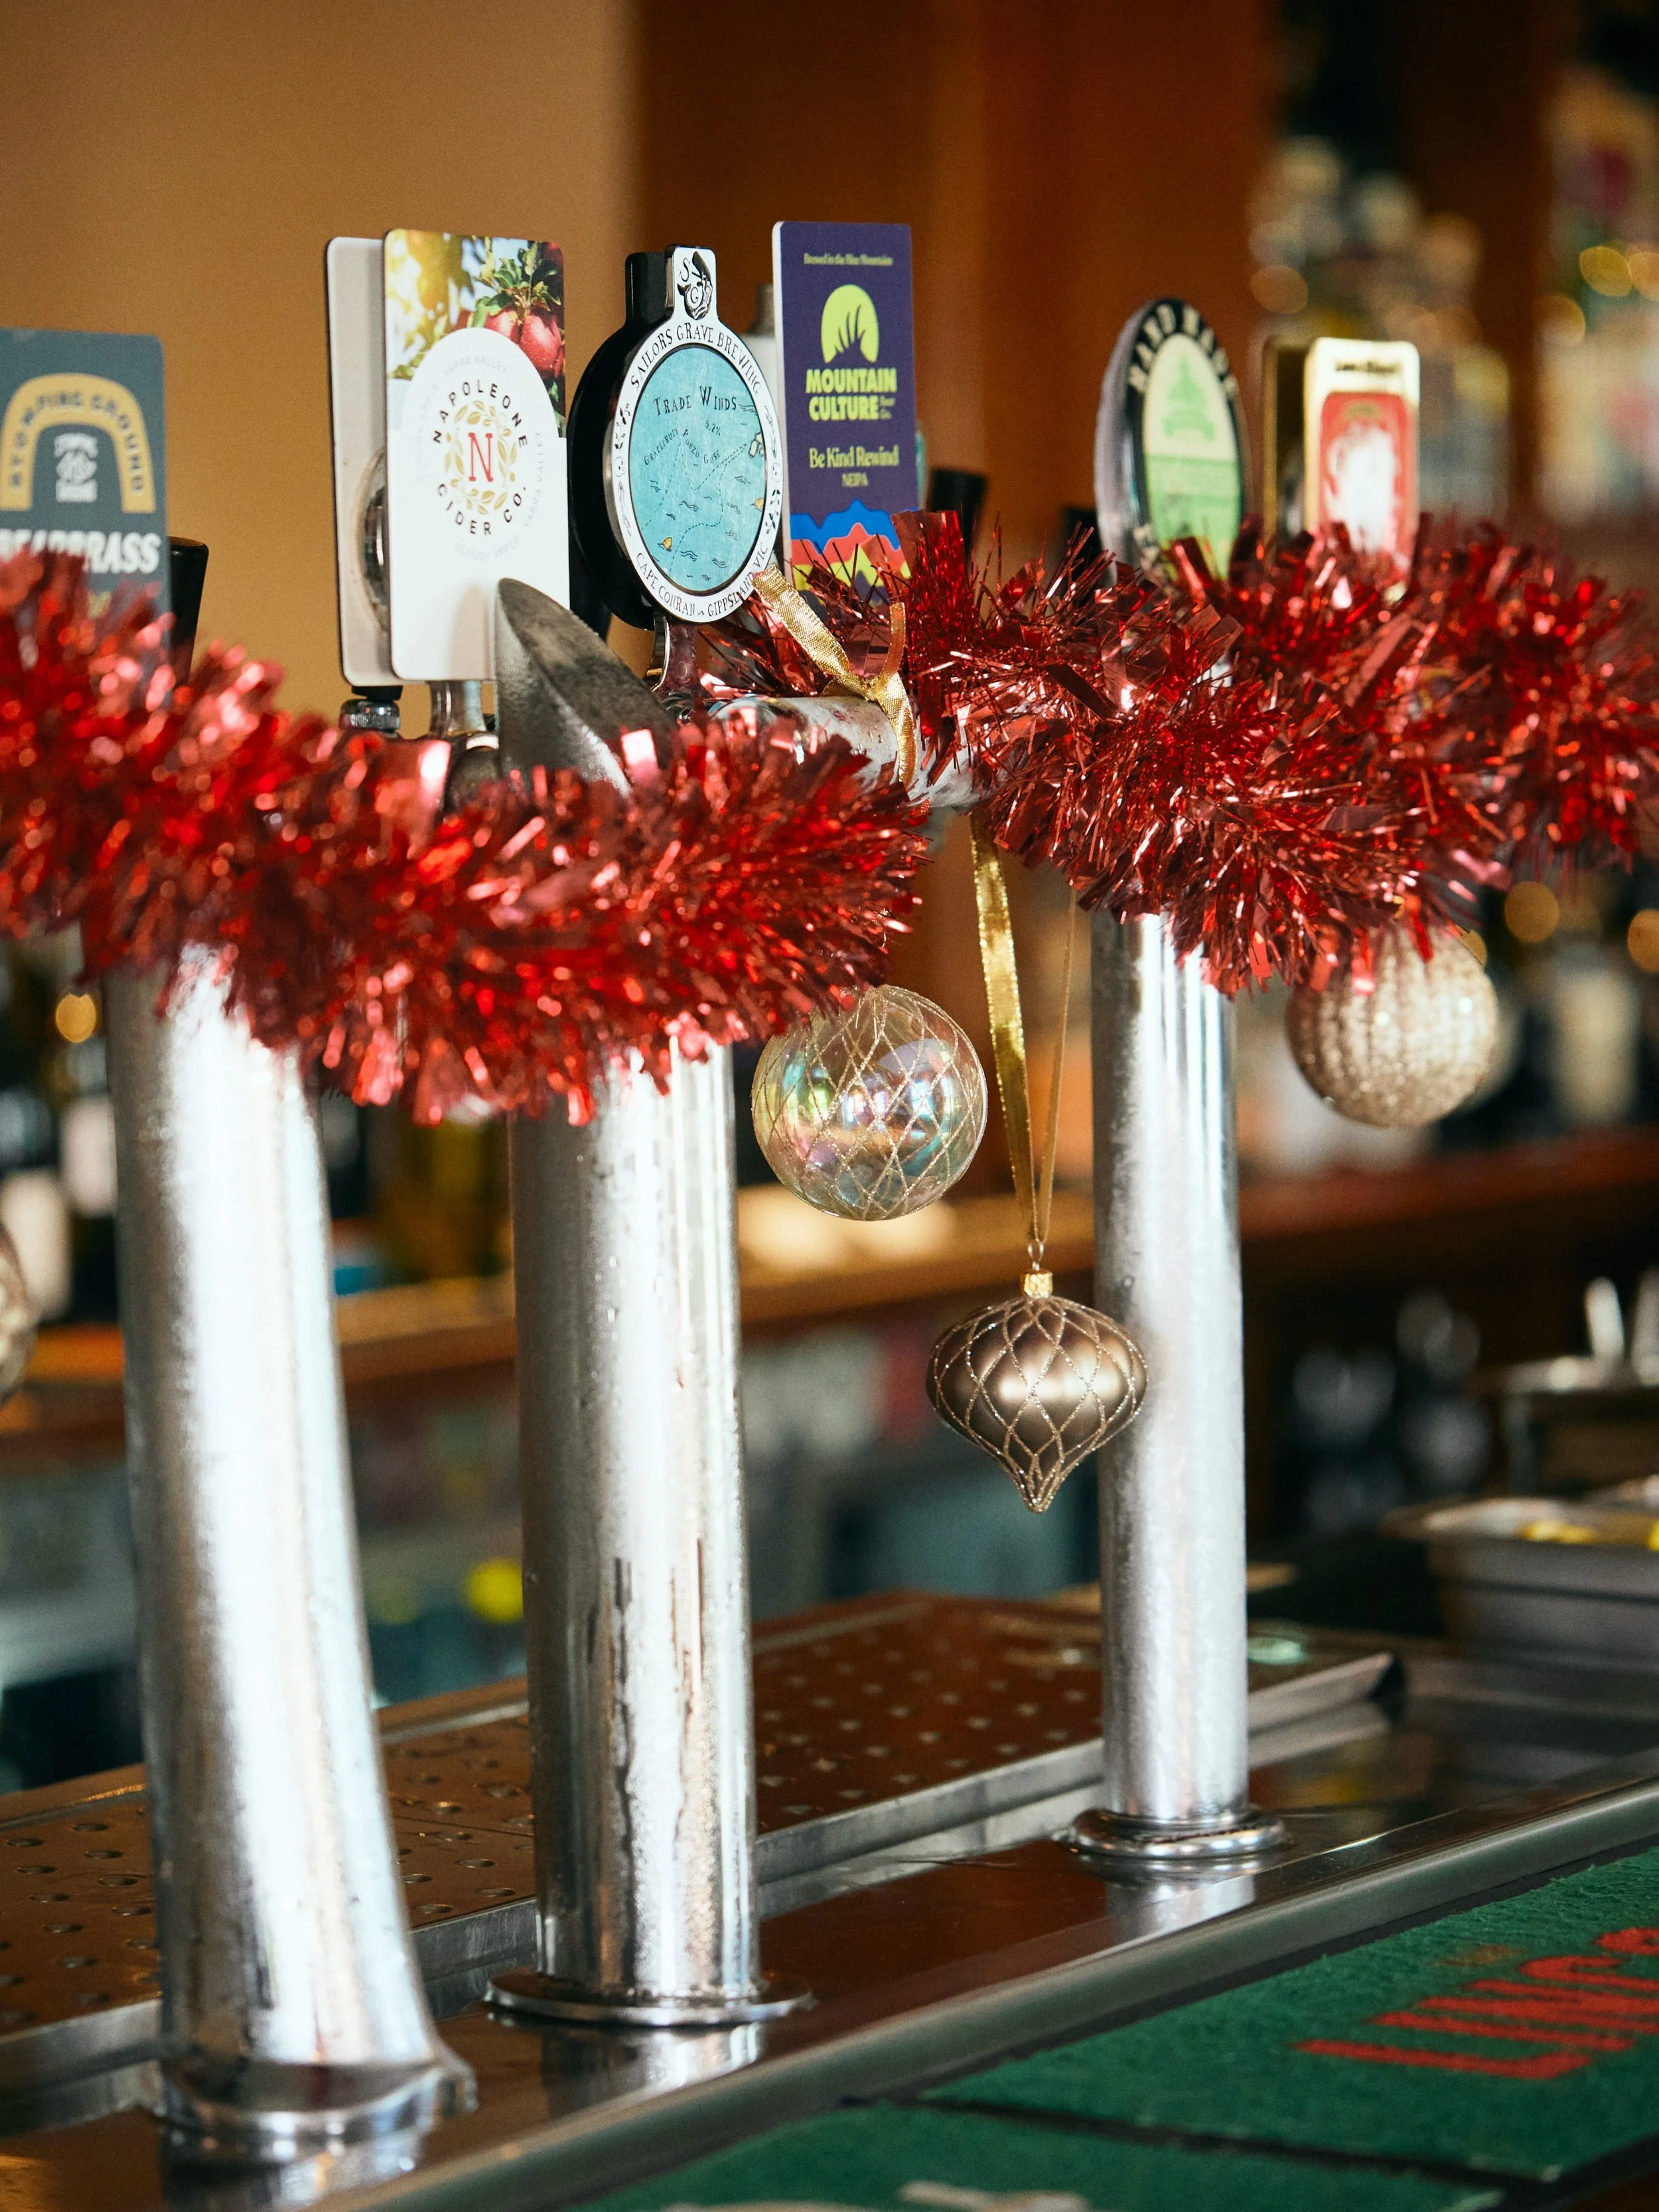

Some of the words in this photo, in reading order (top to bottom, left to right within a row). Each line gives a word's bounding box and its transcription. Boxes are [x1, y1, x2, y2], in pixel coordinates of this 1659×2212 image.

[631, 329, 674, 390] SAILORS
[676, 322, 715, 344] GRAVE
[717, 331, 761, 396] BREWING
[805, 367, 898, 394] MOUNTAIN
[432, 379, 528, 448] NAPOLEONE
[653, 395, 691, 416] TRADE
[698, 385, 737, 411] WINDS
[808, 395, 880, 421] CULTURE
[467, 432, 494, 482] N
[643, 428, 679, 465] GRAPEFRUIT
[682, 428, 700, 458] PONZU
[808, 447, 826, 469] Be
[826, 445, 855, 469] Kind
[855, 443, 901, 467] Rewind
[437, 482, 493, 535] CIDER
[636, 552, 659, 590] CAPE
[658, 585, 696, 616] CONRAN
[707, 571, 755, 617] GIPPSLAND
[753, 542, 768, 569] VIC
